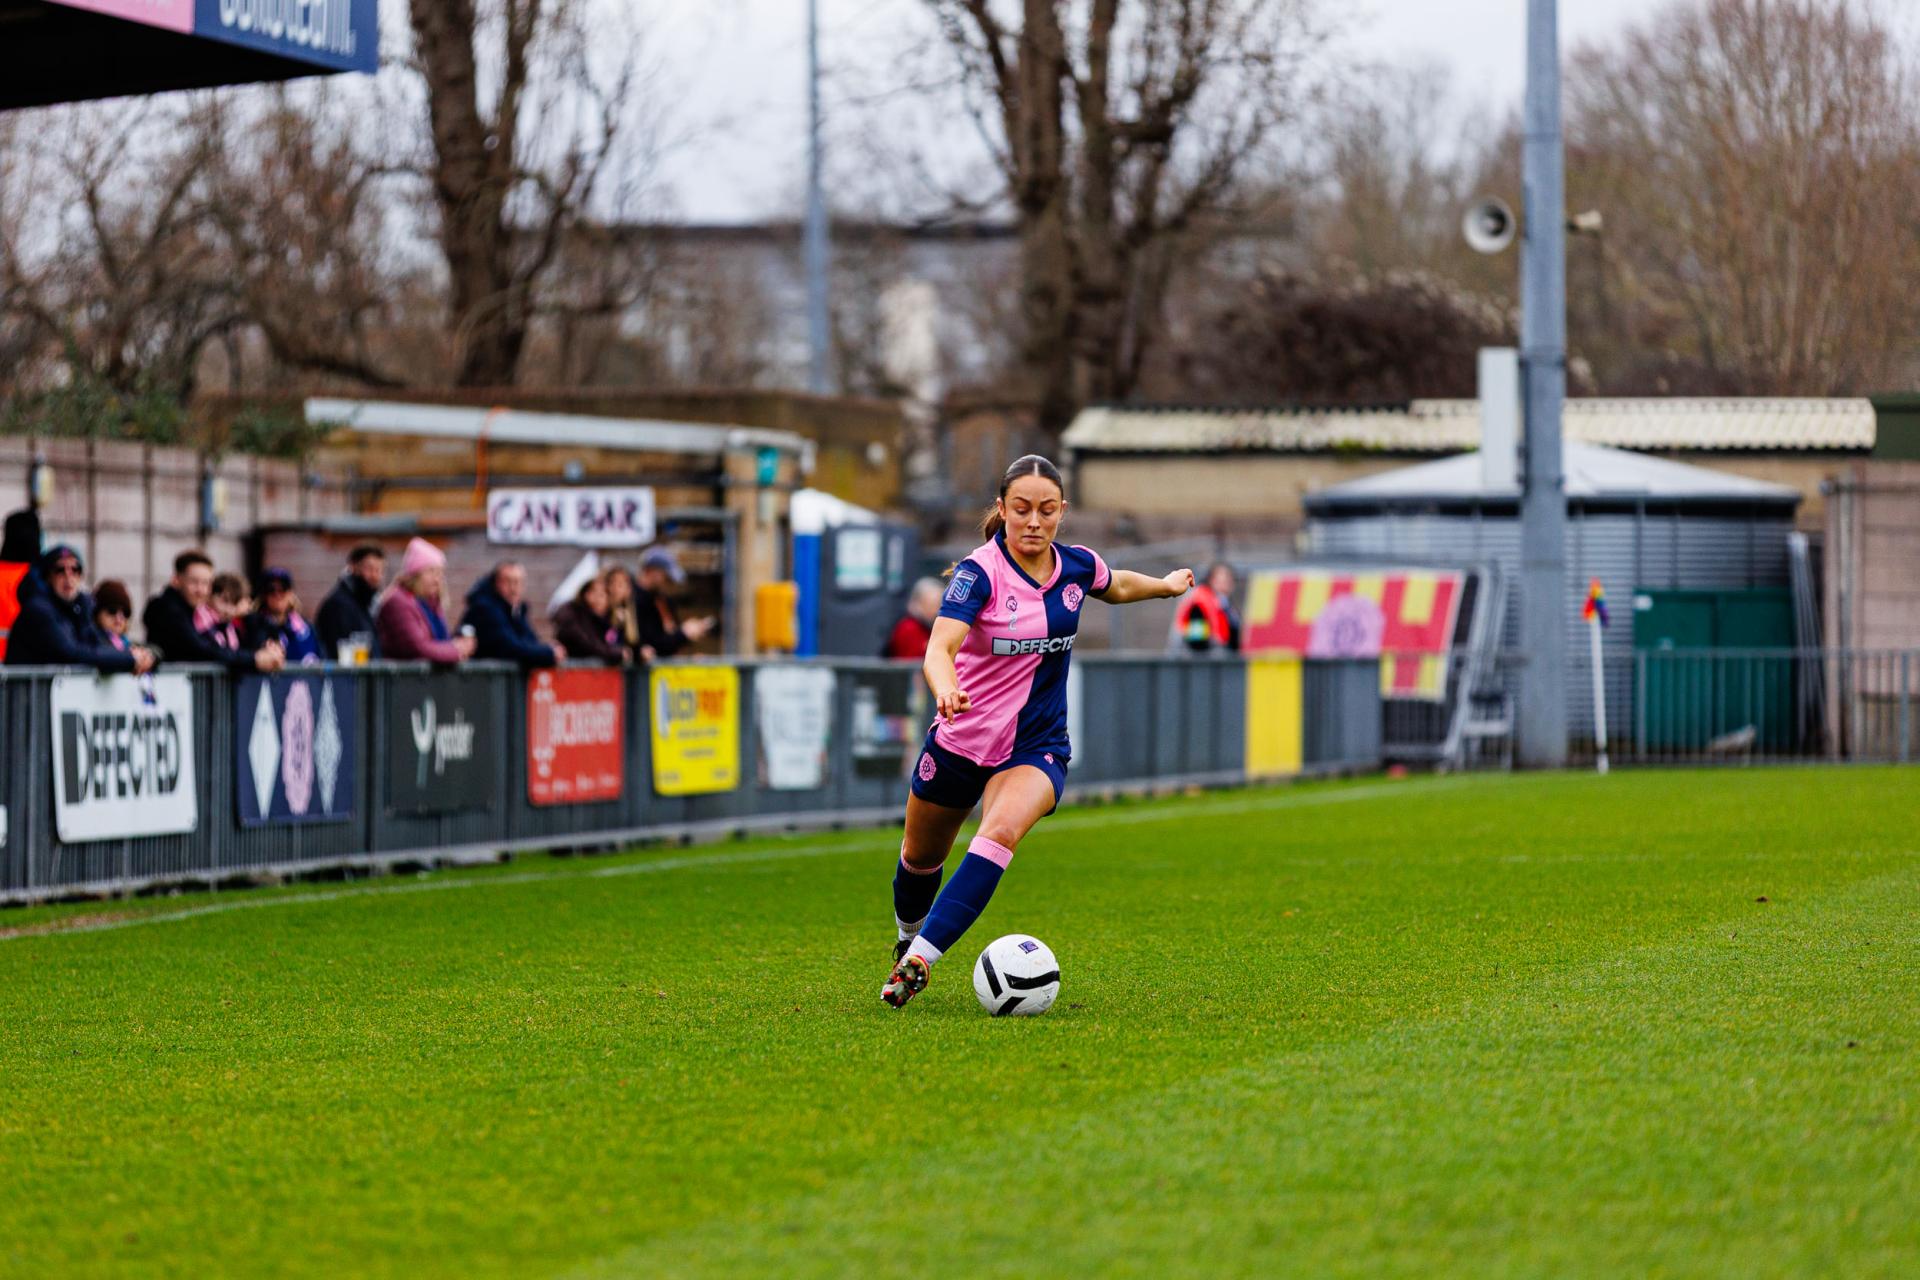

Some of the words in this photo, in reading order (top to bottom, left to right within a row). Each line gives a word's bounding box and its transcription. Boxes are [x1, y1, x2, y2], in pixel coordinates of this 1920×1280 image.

[489, 499, 561, 533] CAN
[578, 498, 642, 532] BAR
[1008, 614, 1018, 631] 2
[993, 633, 1077, 656] DEFECTE
[61, 711, 180, 804] DEFECTED
